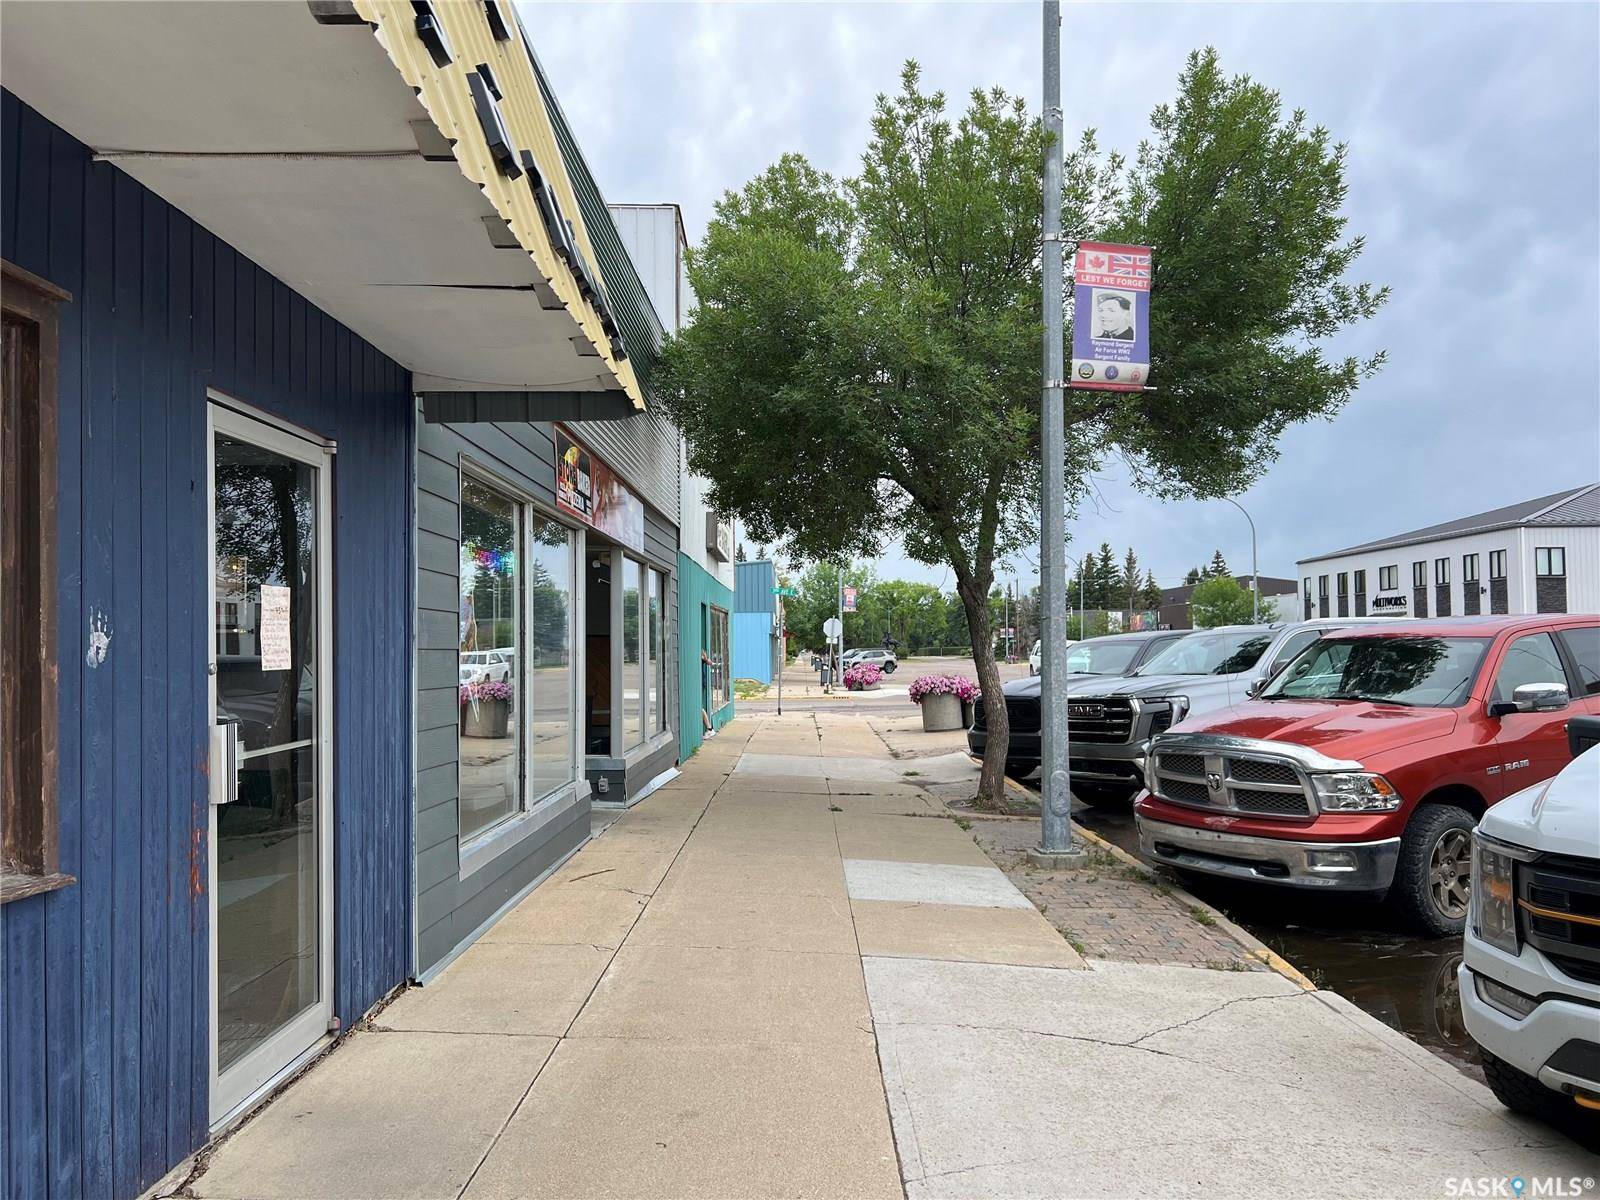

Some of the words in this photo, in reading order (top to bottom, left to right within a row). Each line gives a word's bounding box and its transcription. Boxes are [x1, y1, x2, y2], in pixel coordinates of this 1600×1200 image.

[1081, 274, 1100, 283] LEST
[1103, 276, 1115, 285] WE
[1117, 278, 1148, 287] FORGET
[1505, 760, 1529, 771] RAM
